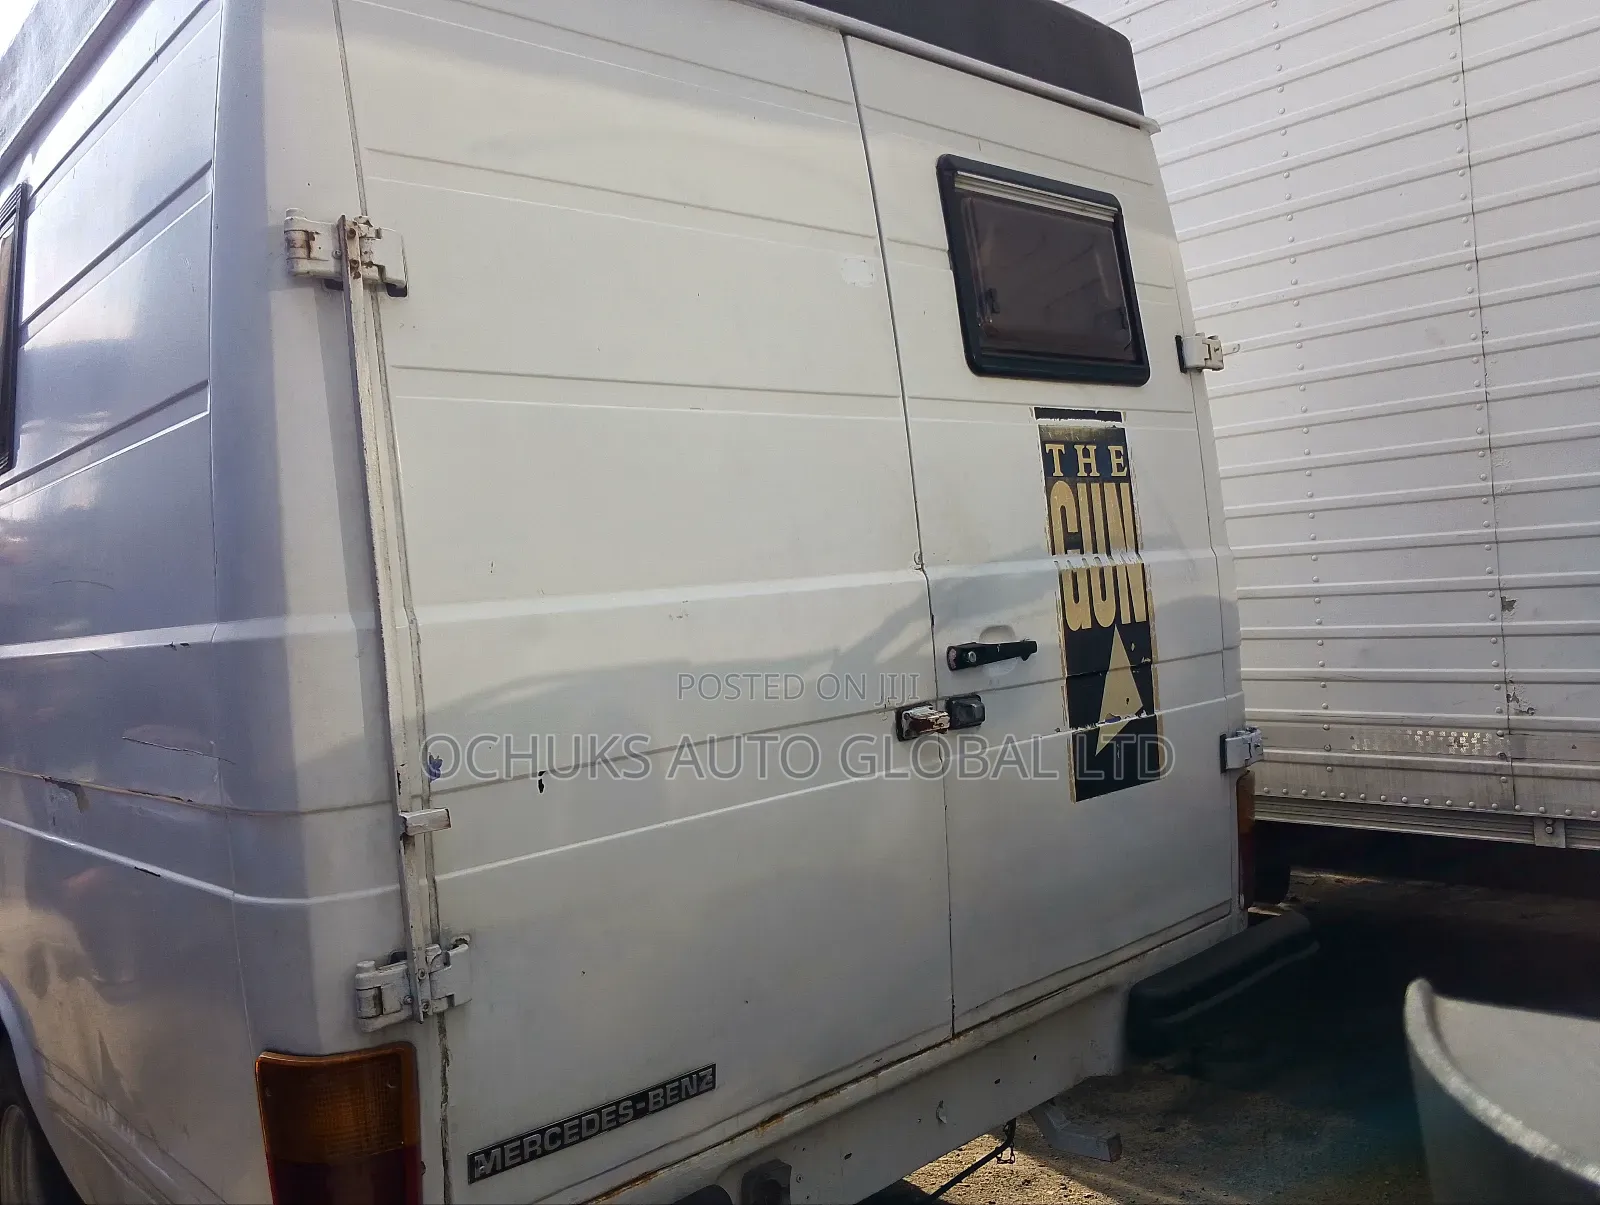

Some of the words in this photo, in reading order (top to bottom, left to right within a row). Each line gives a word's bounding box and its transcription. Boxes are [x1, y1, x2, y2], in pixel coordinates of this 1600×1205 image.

[1045, 443, 1128, 478] THE
[1049, 480, 1148, 632] GUN
[474, 1067, 714, 1179] MERCEDES-BENZ
